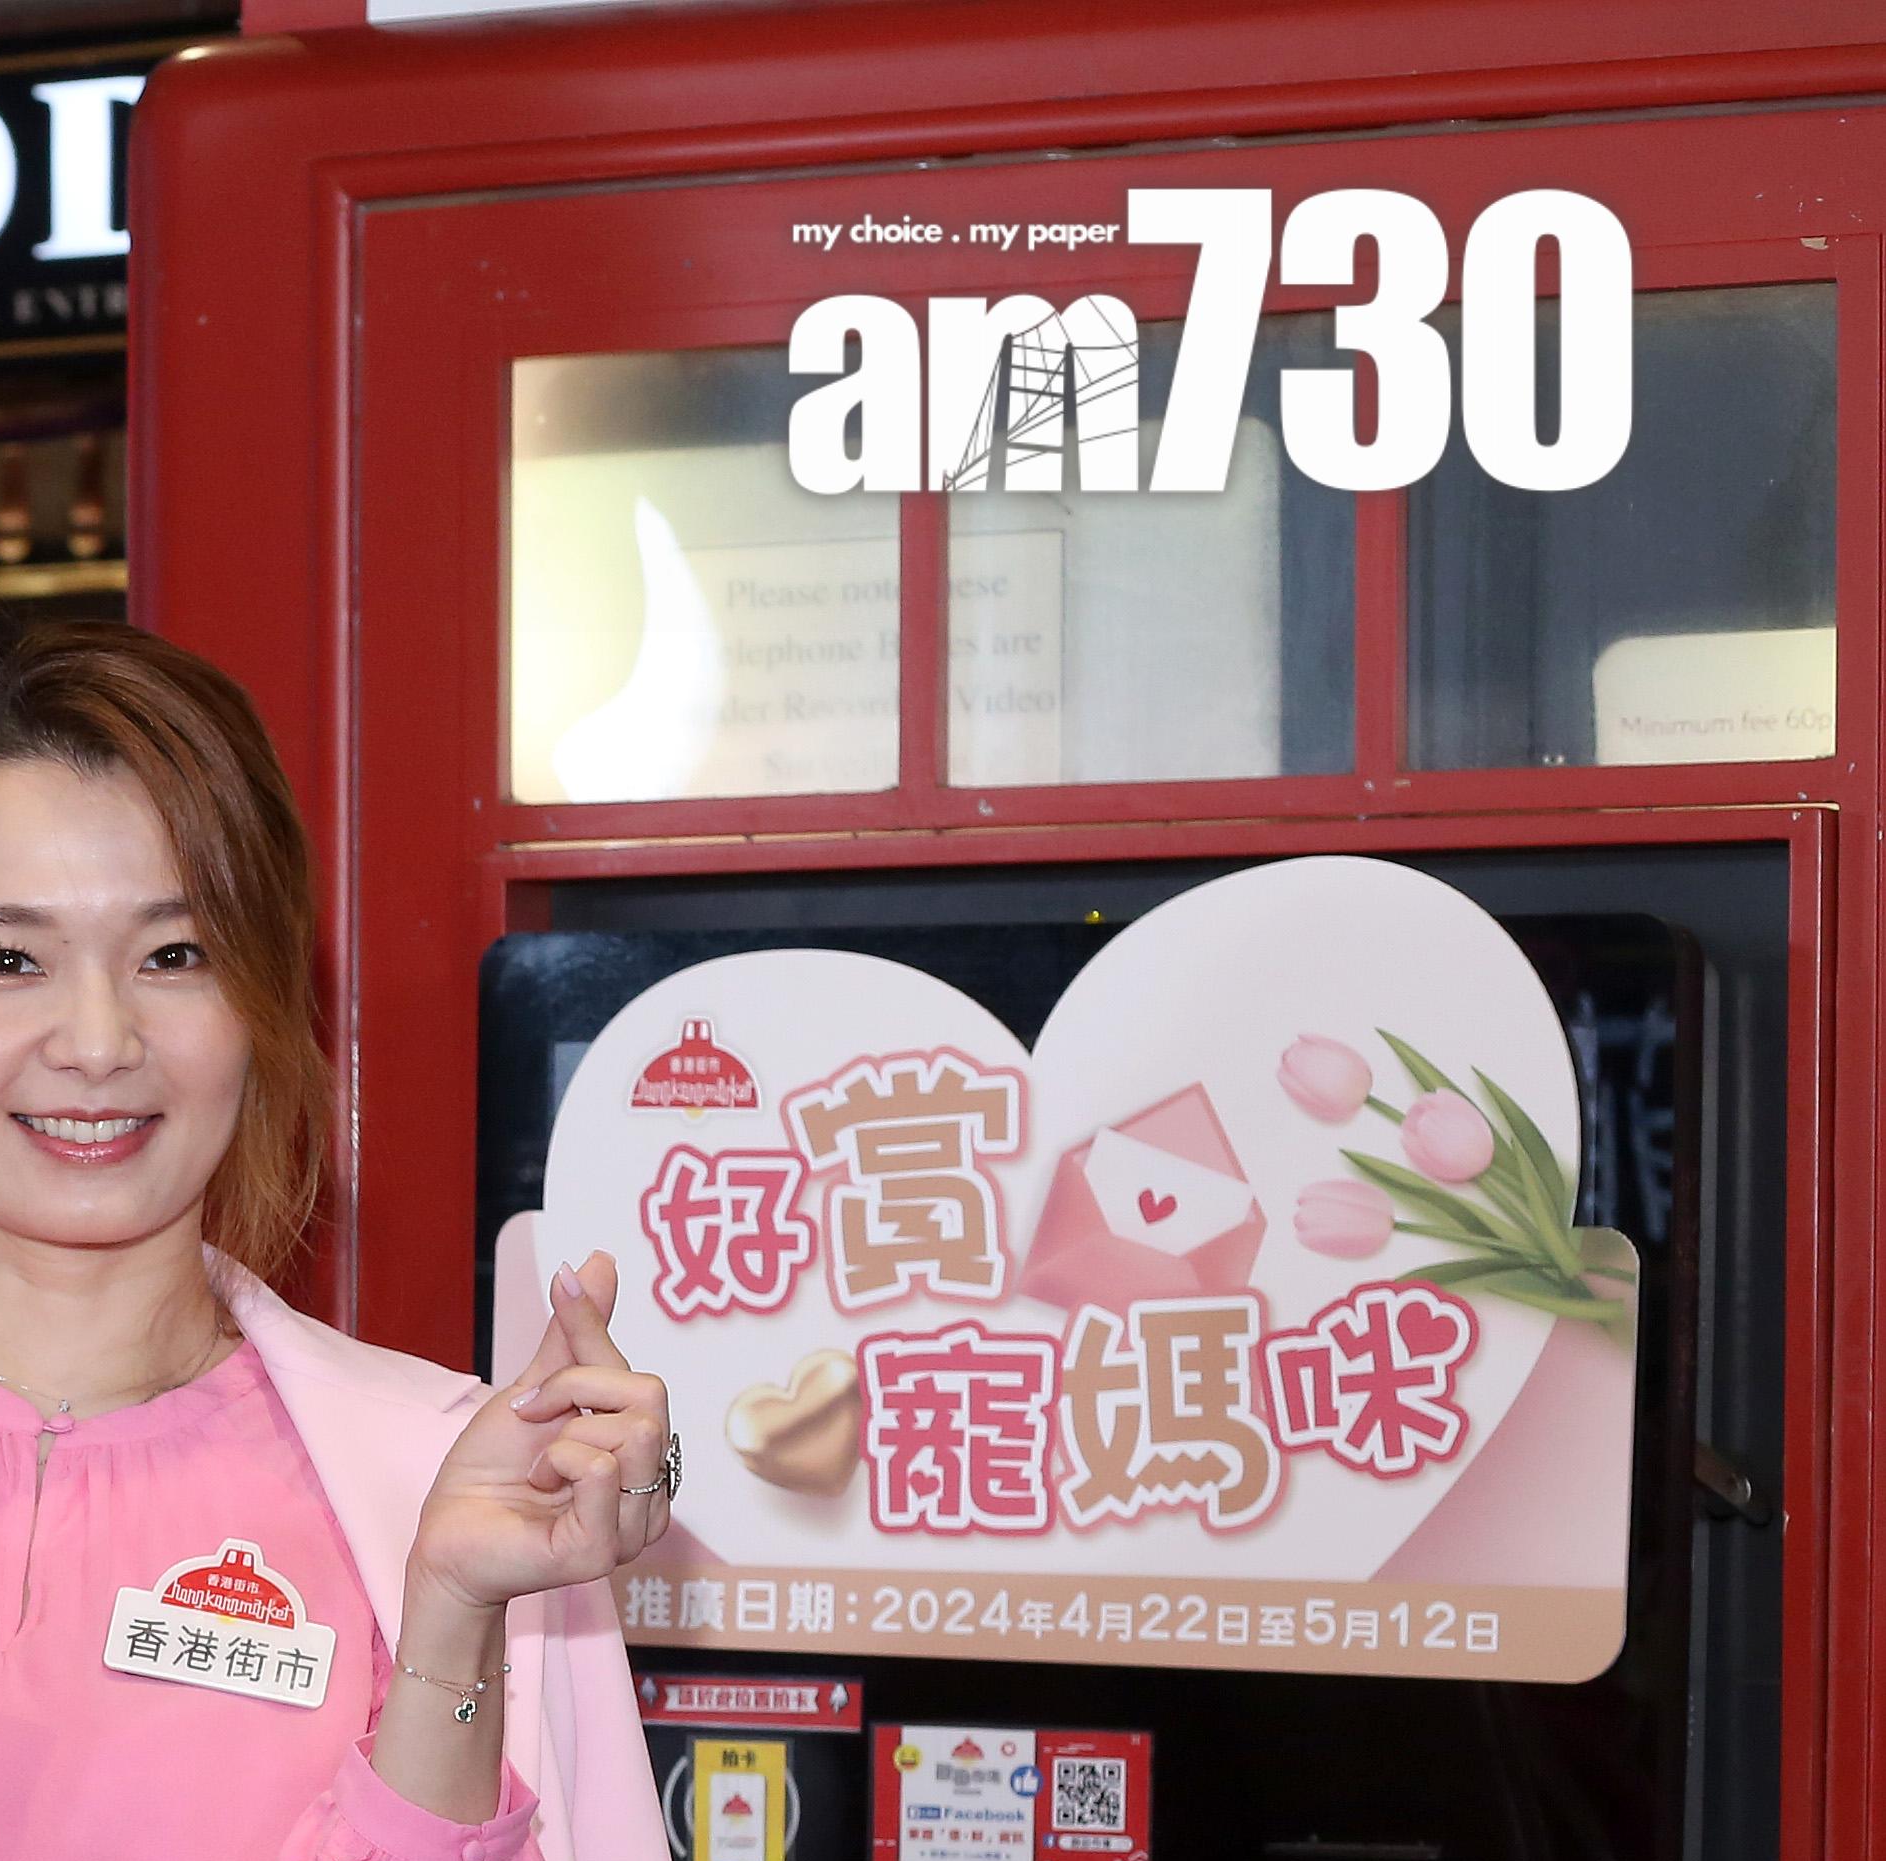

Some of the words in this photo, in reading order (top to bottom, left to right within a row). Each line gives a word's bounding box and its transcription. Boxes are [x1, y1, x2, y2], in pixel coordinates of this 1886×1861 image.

[647, 1058, 1019, 1314] 好賞
[870, 1290, 1473, 1530] 寵媽咪
[125, 1618, 319, 1690] 香港街市
